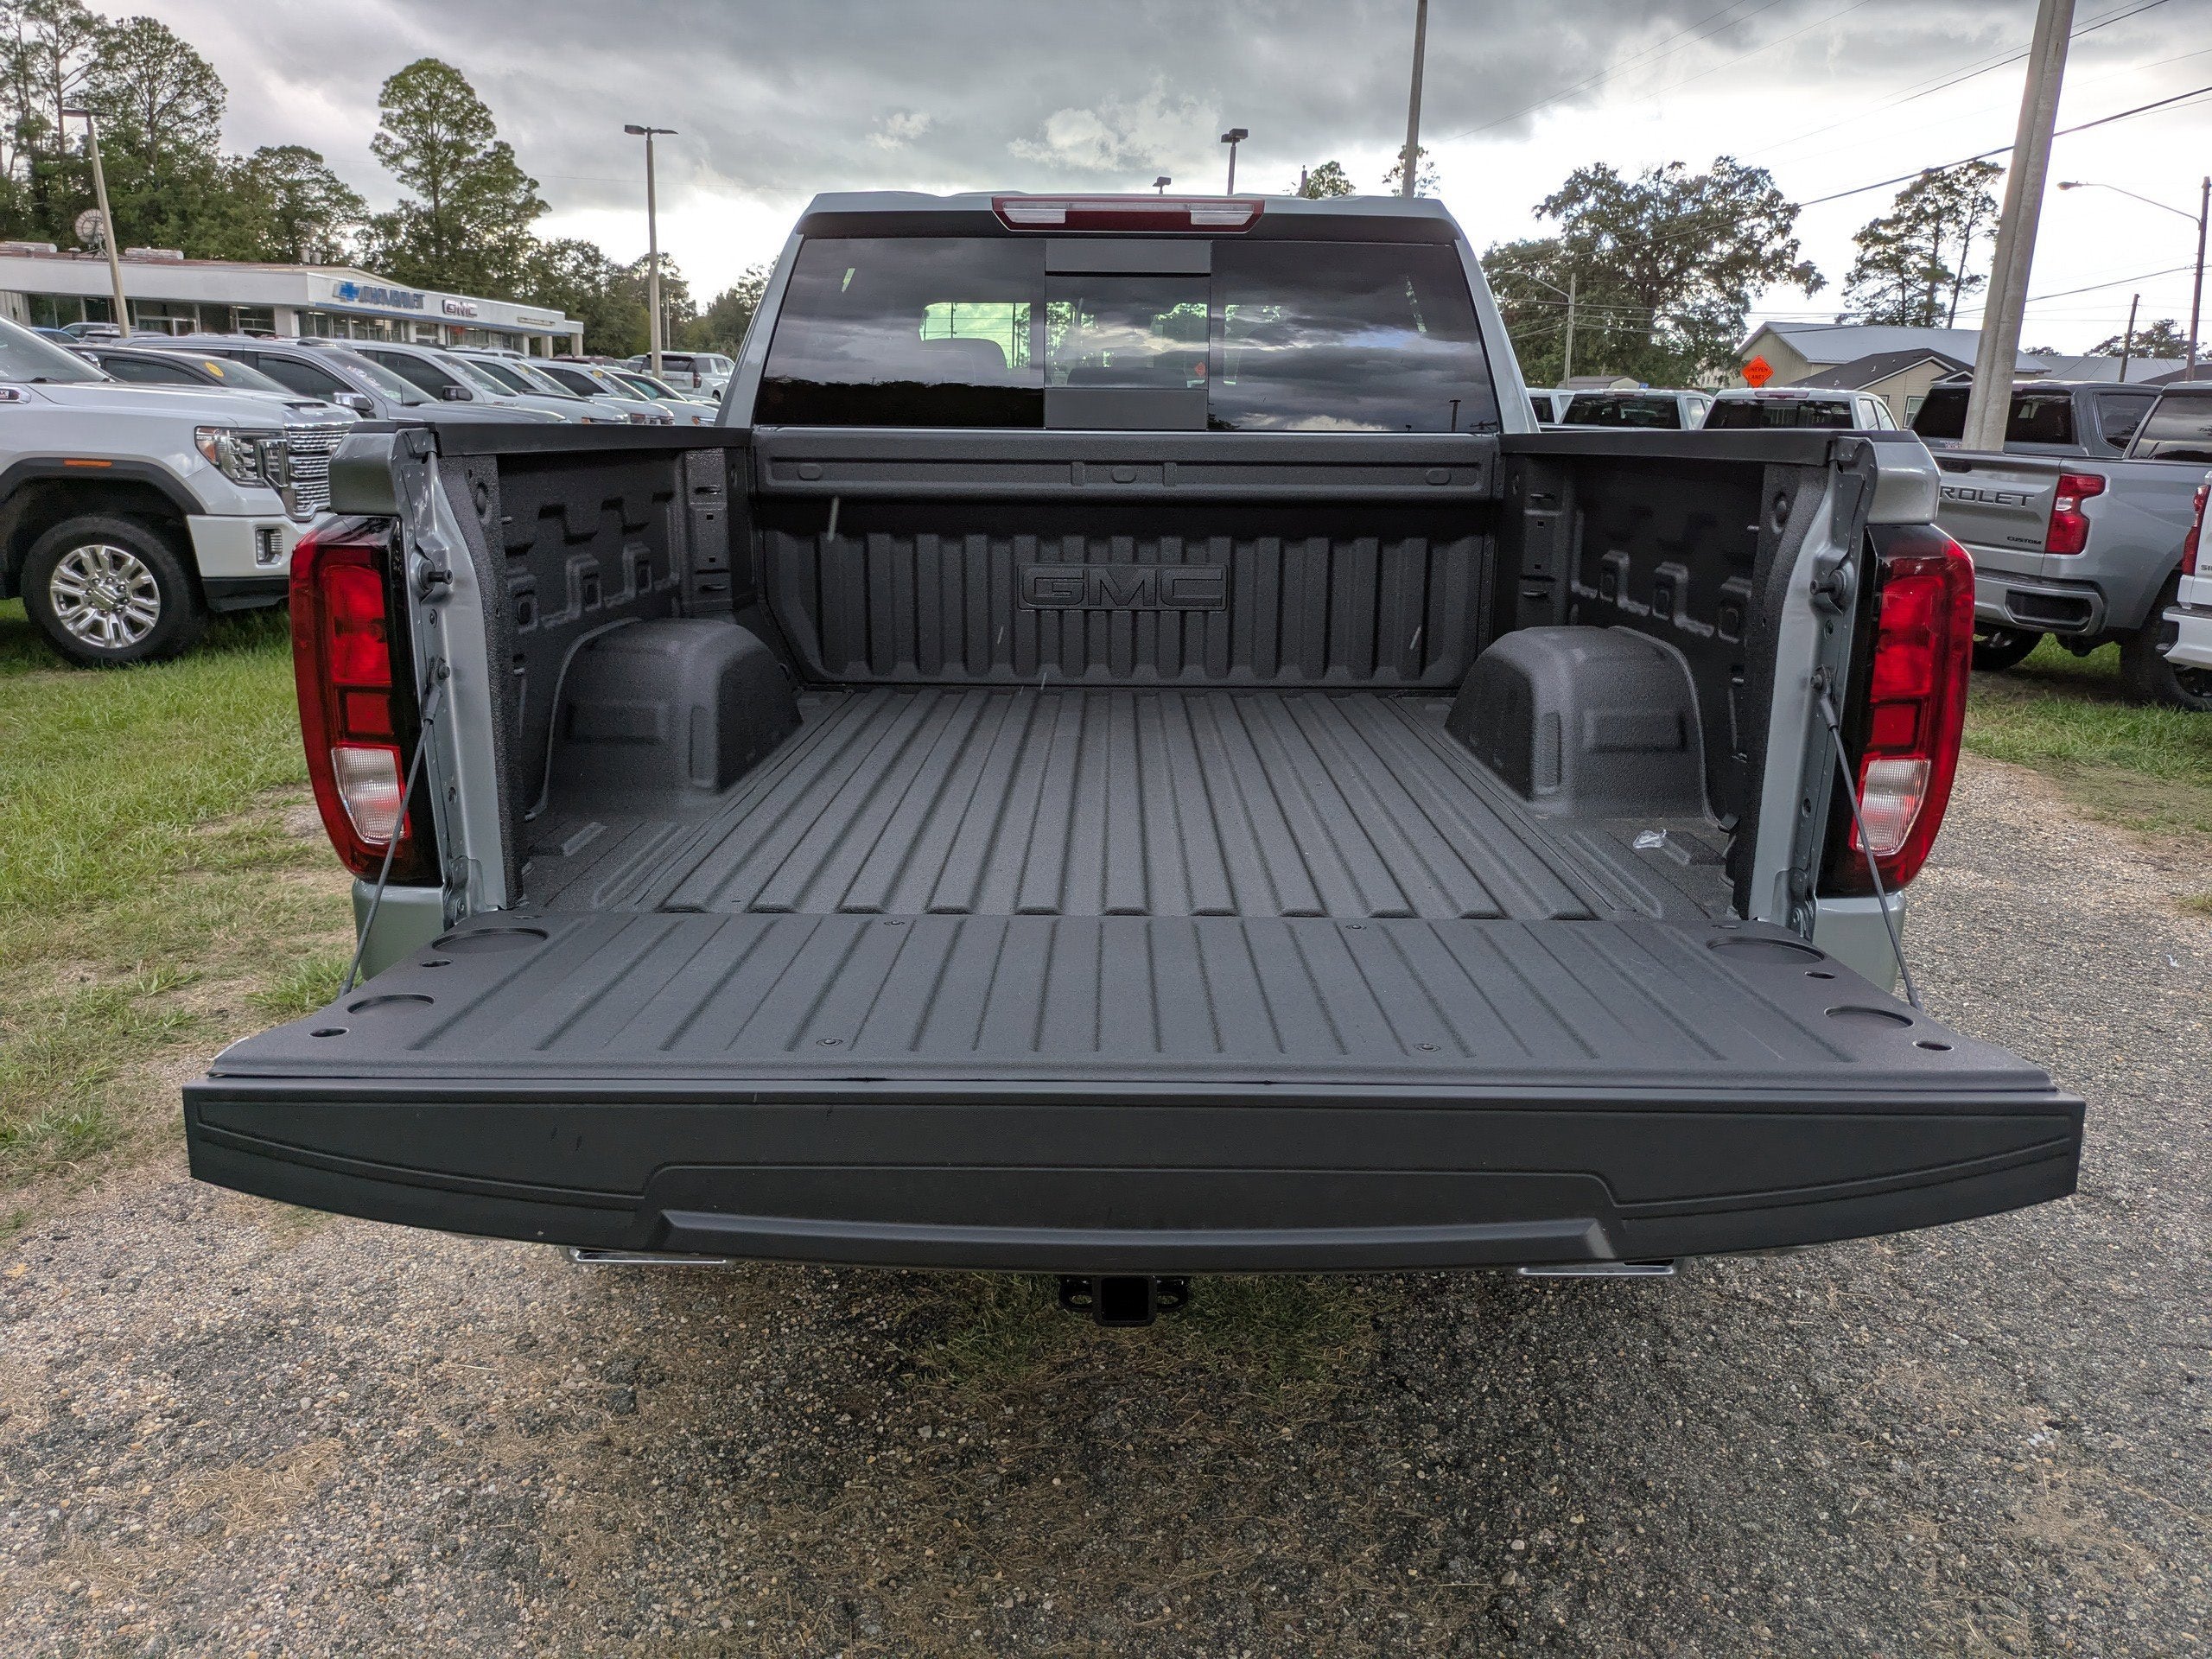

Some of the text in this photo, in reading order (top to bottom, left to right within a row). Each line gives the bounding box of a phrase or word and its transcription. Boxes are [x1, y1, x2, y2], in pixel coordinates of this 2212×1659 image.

[442, 299, 478, 317] GMC
[2006, 536, 2042, 544] CUSTOM
[1021, 566, 1224, 607] GMC
